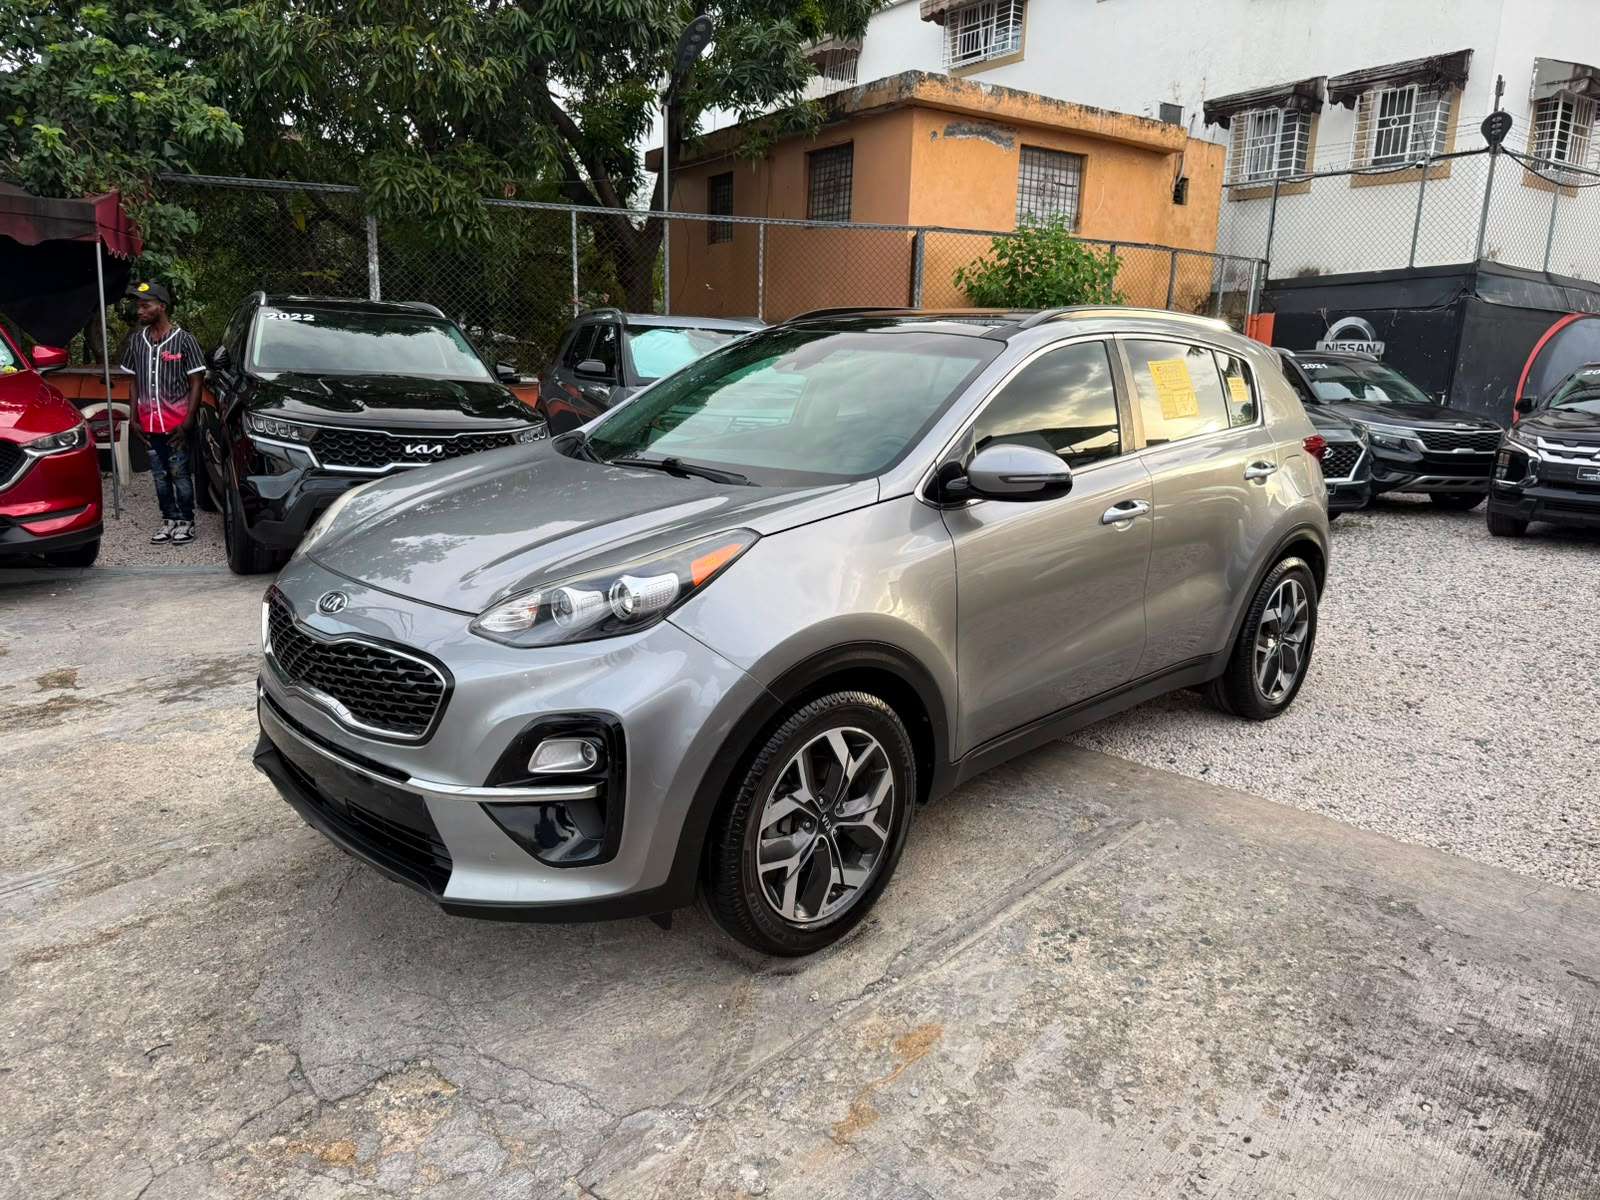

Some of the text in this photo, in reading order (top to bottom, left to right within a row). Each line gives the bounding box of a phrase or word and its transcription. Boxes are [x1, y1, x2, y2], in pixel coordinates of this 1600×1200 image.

[263, 312, 315, 322] 2022
[1325, 343, 1376, 353] NISSAN
[405, 444, 443, 454] KIA
